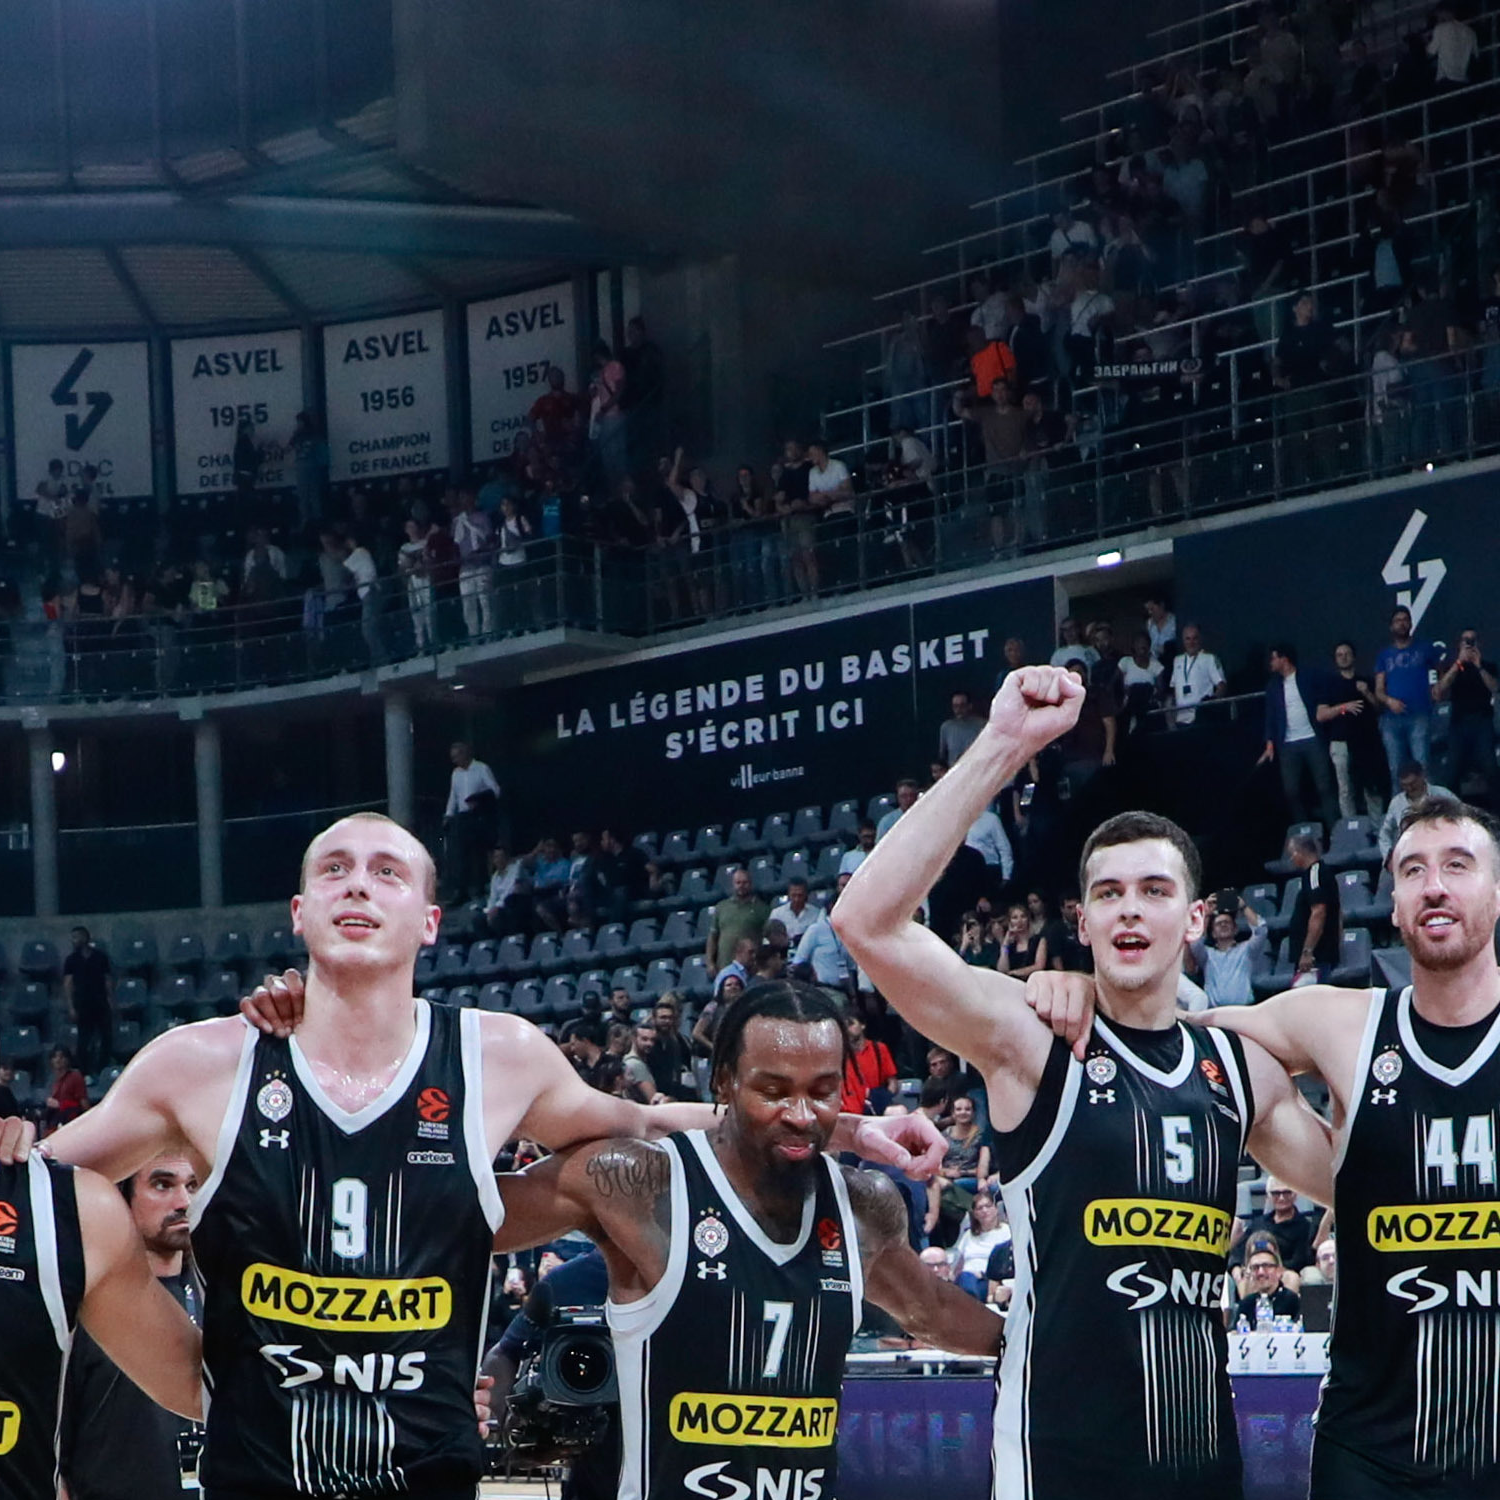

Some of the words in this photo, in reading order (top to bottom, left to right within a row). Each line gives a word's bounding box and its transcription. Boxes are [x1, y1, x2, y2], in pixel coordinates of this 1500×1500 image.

[486, 302, 564, 340] ASVEL
[191, 348, 283, 379] ASVEL
[343, 329, 429, 364] ASVEL
[503, 360, 551, 390] 1957
[210, 403, 269, 428] 1955
[360, 386, 415, 413] 1956
[348, 432, 430, 455] CHAMPION
[351, 457, 371, 474] DE
[373, 451, 430, 472] FRANCE
[557, 708, 595, 738] LA
[610, 672, 764, 729] LÉGENDE
[780, 663, 824, 696] DU
[841, 629, 990, 685] BASKET
[665, 708, 800, 759] S'ÉCRIT
[816, 698, 864, 732] ICI
[1162, 1115, 1195, 1184] 5
[1424, 1114, 1496, 1186] 44
[332, 1177, 368, 1260] 9
[248, 1272, 444, 1322] MOZZART
[762, 1301, 795, 1378] 7
[333, 1350, 426, 1393] NIS
[676, 1400, 834, 1438] MOZZART
